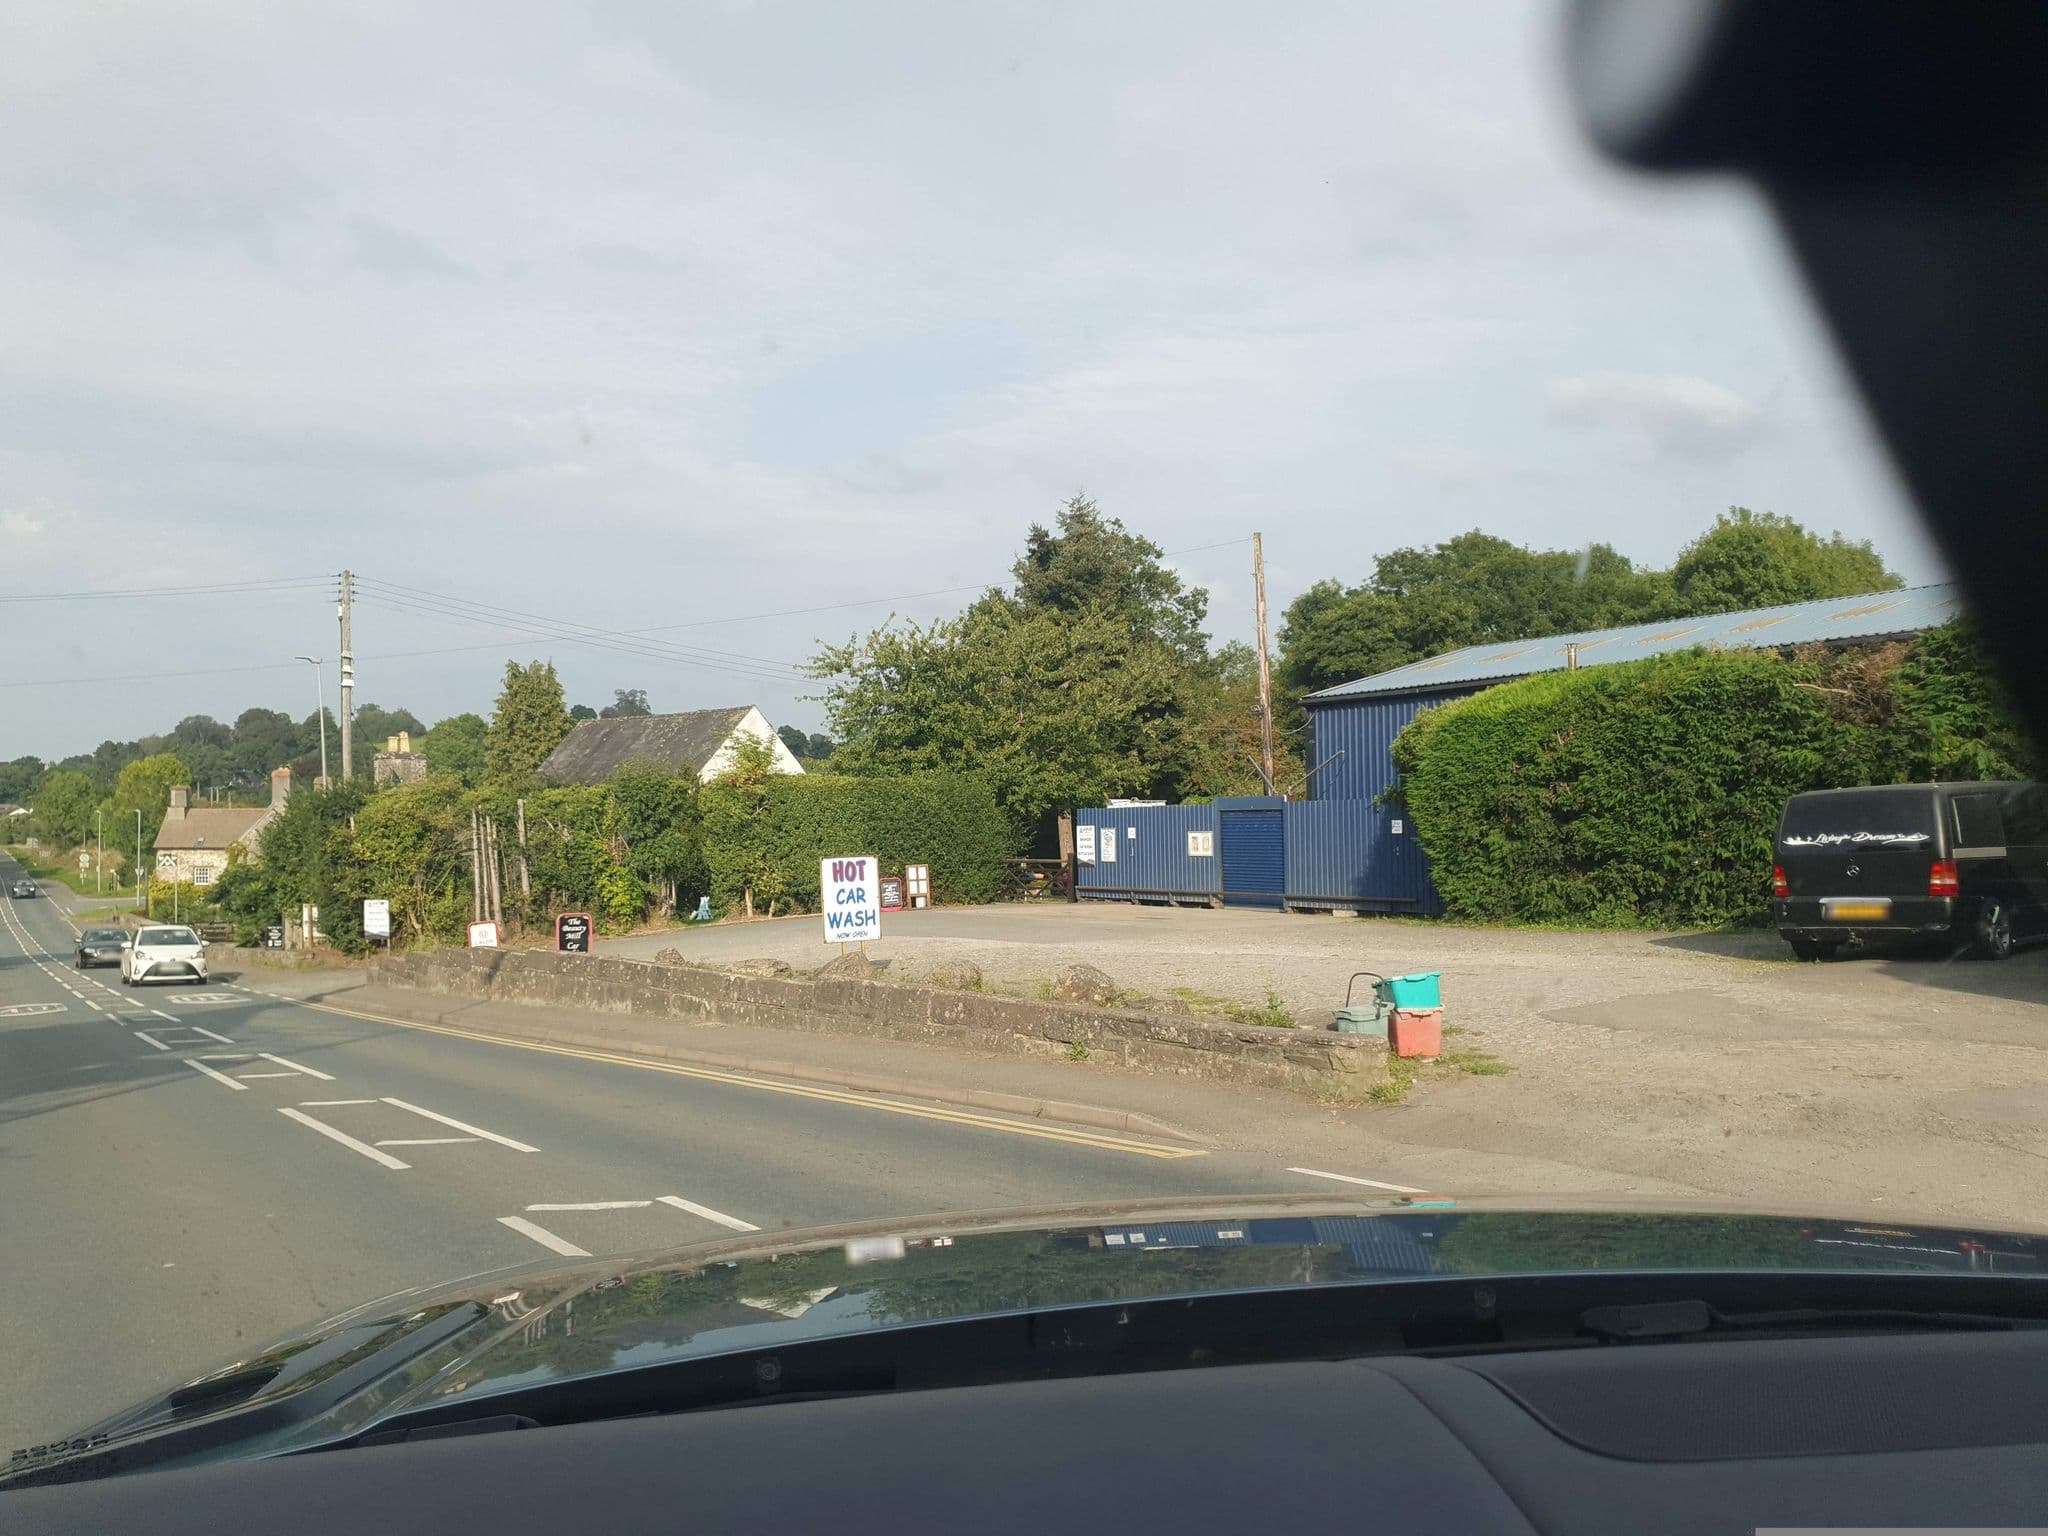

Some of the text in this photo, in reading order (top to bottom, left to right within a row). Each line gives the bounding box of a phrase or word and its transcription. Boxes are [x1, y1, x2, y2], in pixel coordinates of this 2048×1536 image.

[832, 860, 866, 882] HOT
[836, 887, 866, 904] CAR
[827, 909, 876, 929] WASH
